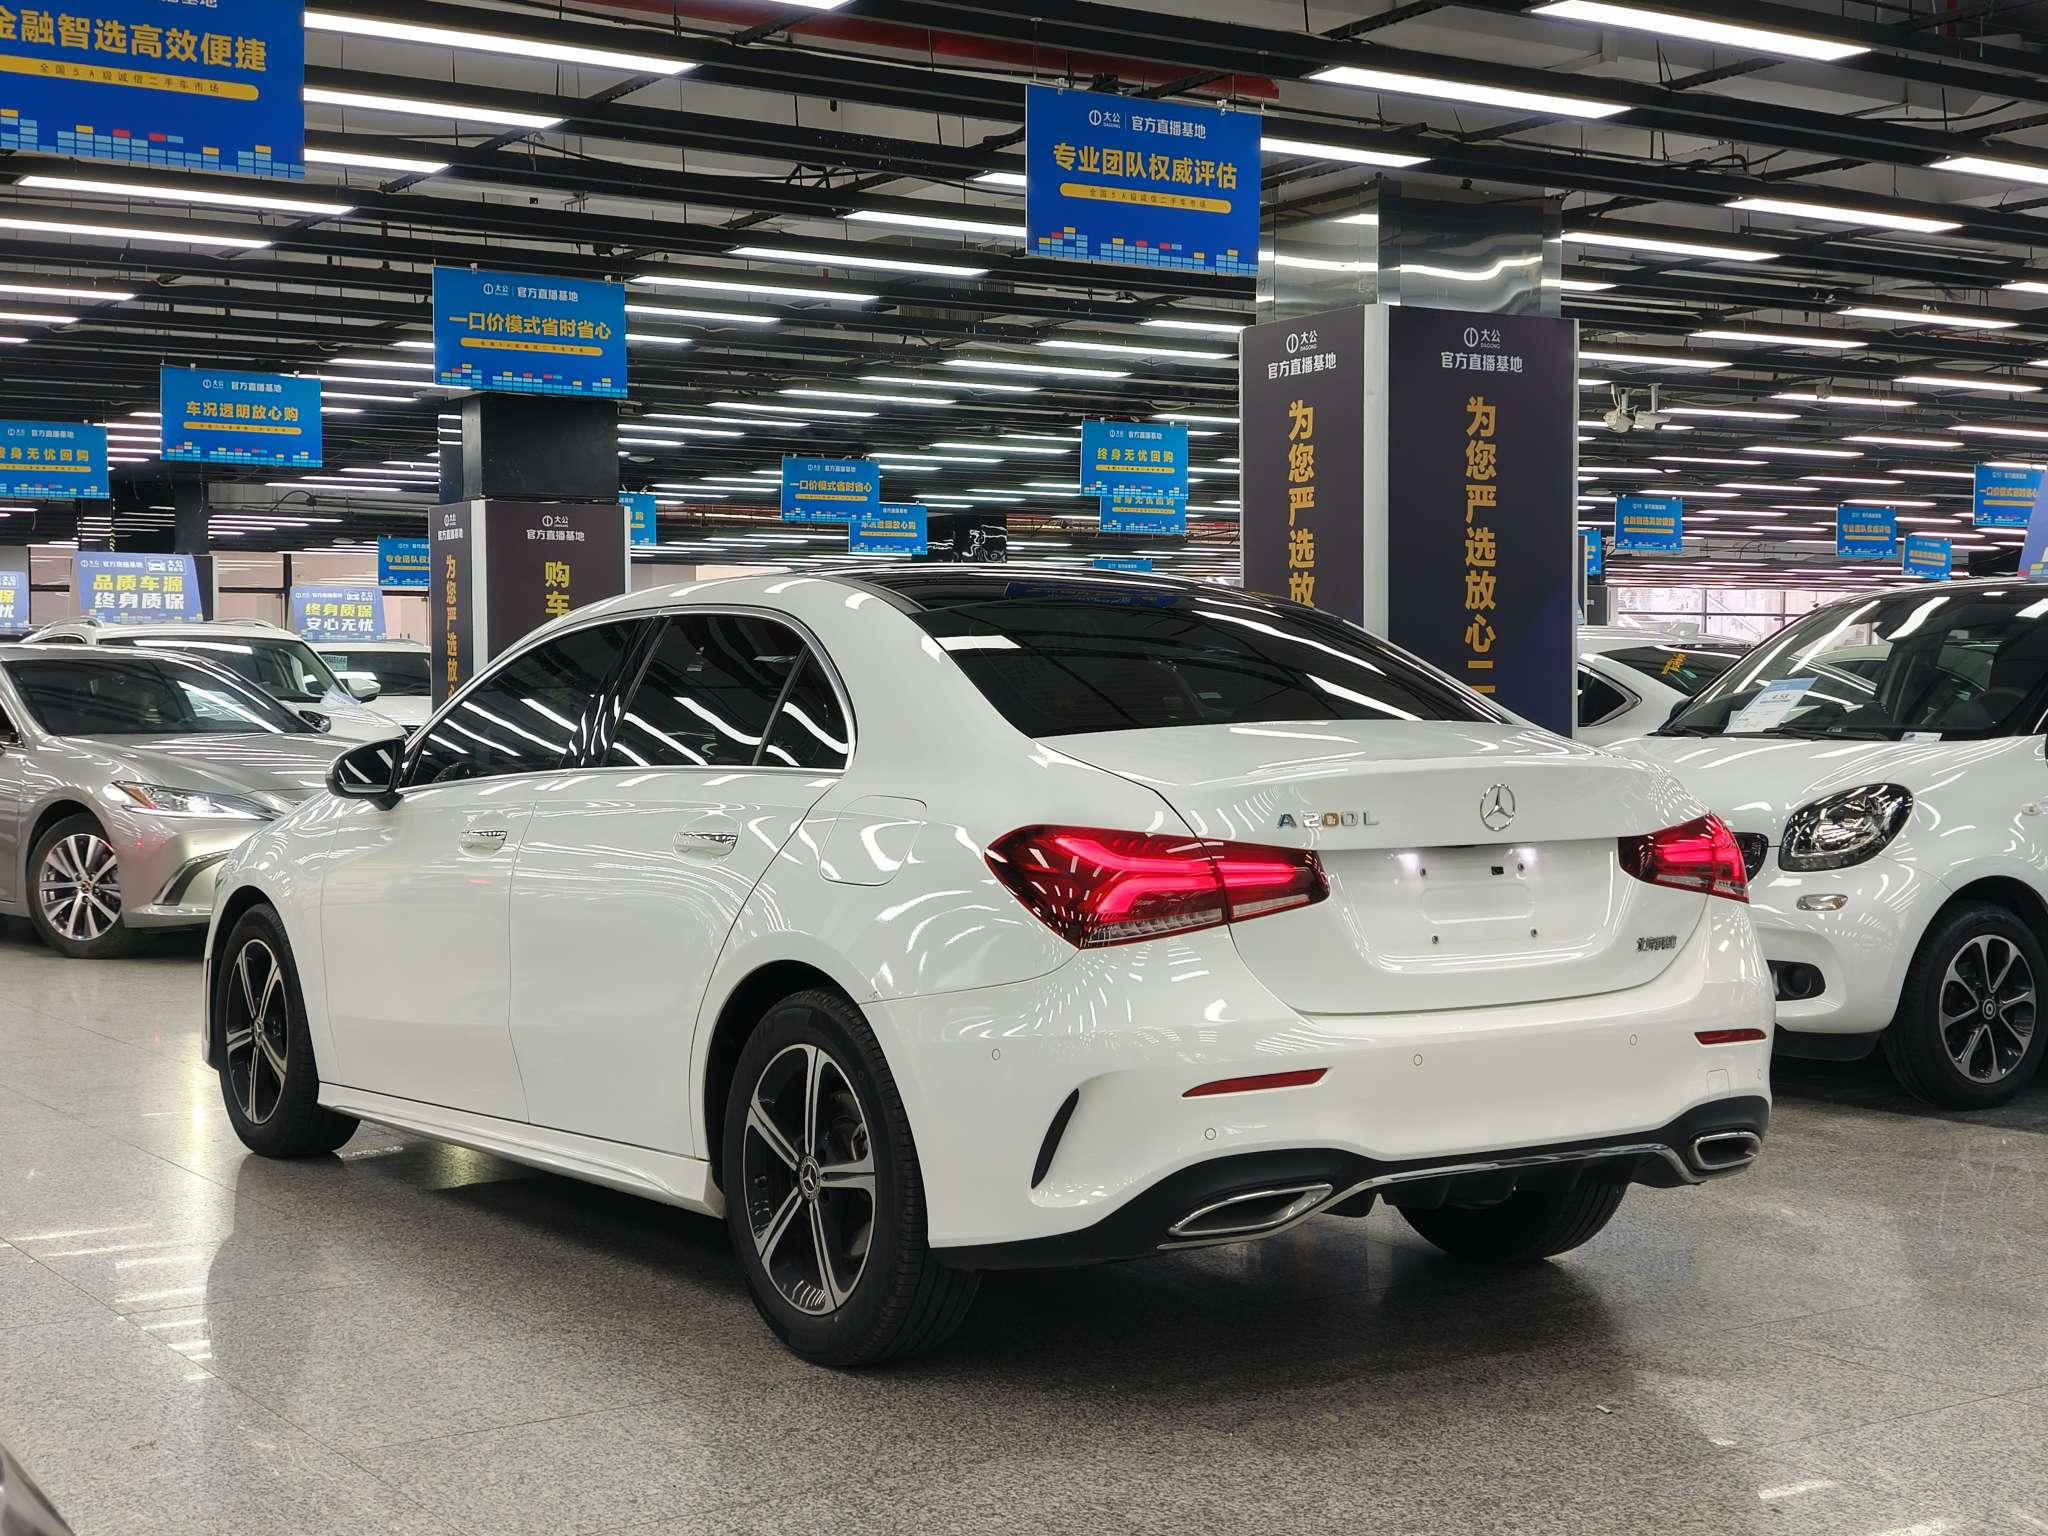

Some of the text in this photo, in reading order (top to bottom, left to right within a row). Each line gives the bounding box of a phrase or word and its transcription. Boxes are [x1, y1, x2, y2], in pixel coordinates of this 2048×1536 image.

[1103, 111, 1206, 139] 大公 官方直播基地
[1053, 142, 1238, 190] 专业团队权威评估
[449, 312, 611, 340] 一口价模式省时省心
[1481, 328, 1501, 342] 大公
[1300, 330, 1318, 345] 大公
[1267, 352, 1337, 380] 官方直播基地
[1441, 351, 1523, 373] 官方直播基地
[186, 401, 299, 422] 车况透明放心购
[1097, 447, 1175, 463] 终身无忧回购
[1288, 400, 1315, 608] 为您严选放
[554, 515, 569, 524] 大公
[1465, 395, 1497, 695] 为您严选放心二
[93, 574, 183, 592] 品质车源
[95, 592, 184, 610] 终身质保
[305, 603, 373, 617] 终身质保
[306, 617, 374, 632] 安心无忧
